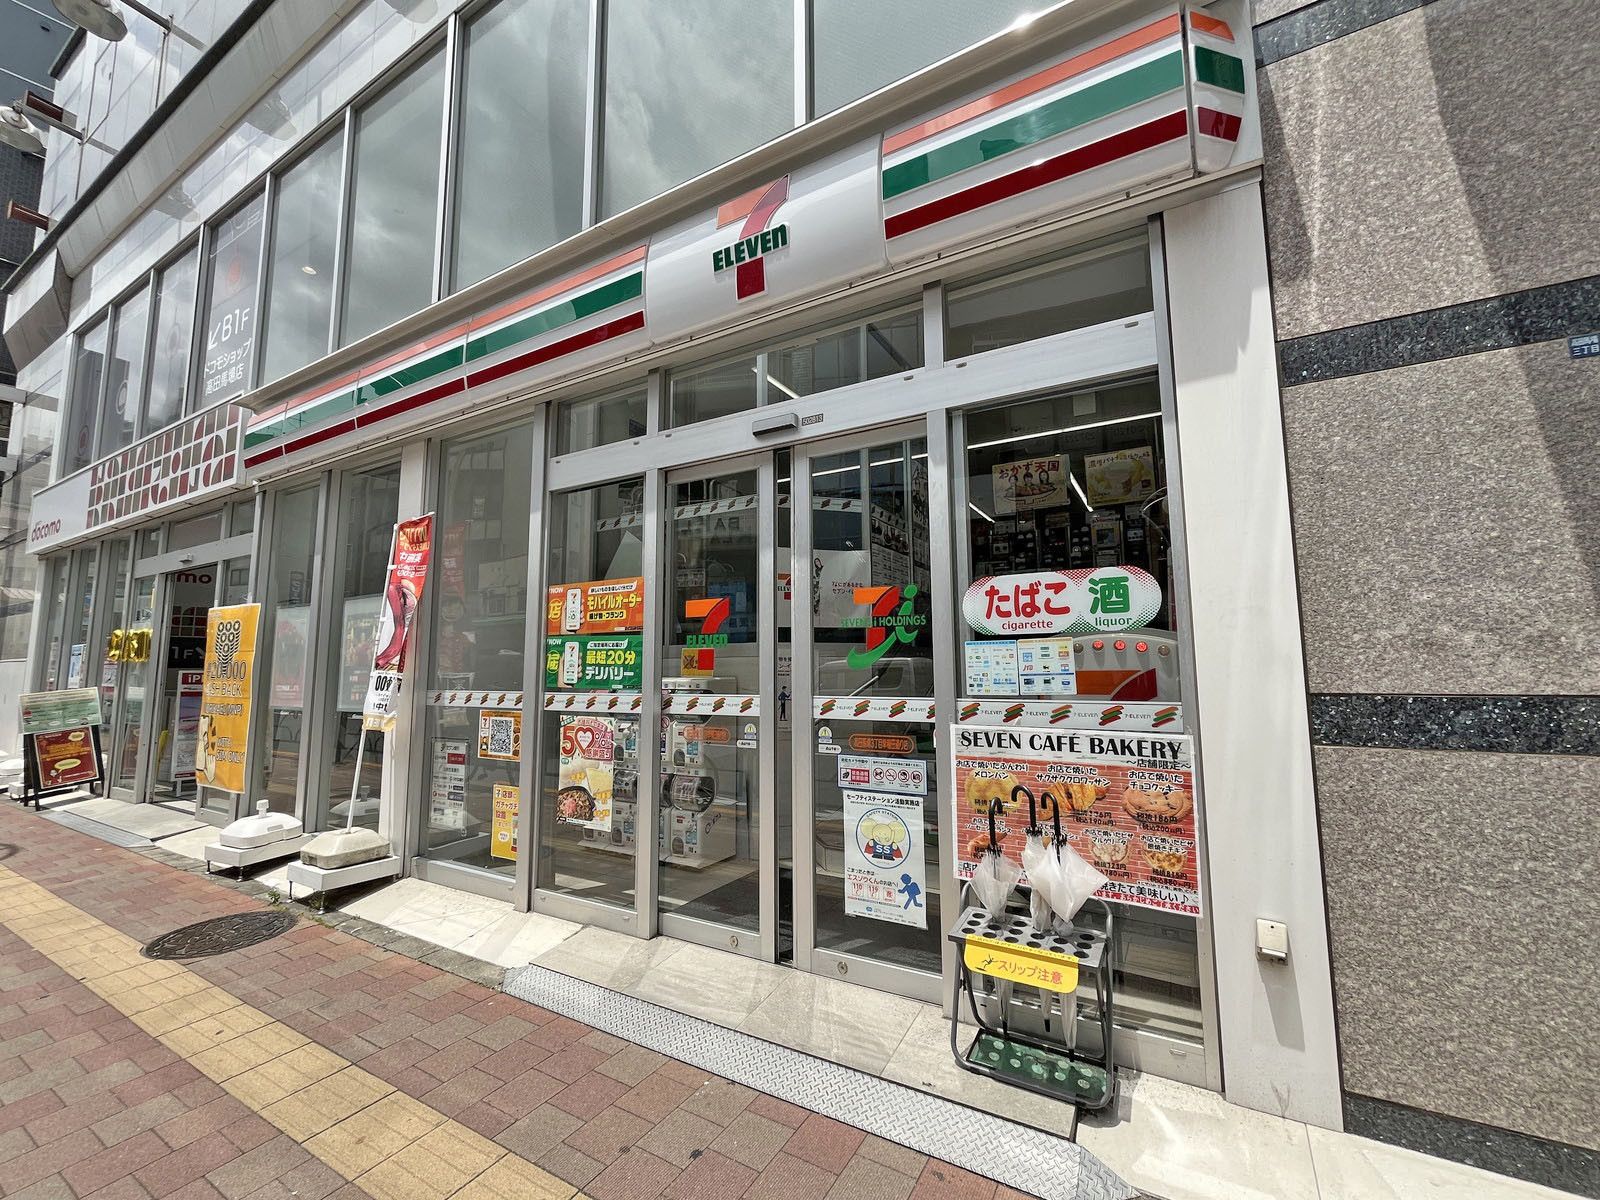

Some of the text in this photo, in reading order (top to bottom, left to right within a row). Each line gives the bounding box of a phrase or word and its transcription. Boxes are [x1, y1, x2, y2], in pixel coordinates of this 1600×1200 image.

[999, 460, 1060, 480] おかず天国
[31, 518, 61, 542] docomo
[587, 592, 642, 610] モバイルオーダー
[985, 580, 1070, 619] たばこ
[1088, 576, 1130, 614] 酒
[879, 615, 926, 627] HOLDINGS
[1001, 620, 1054, 632] cigarette
[1094, 616, 1133, 628] liquor
[585, 650, 636, 665] 最短20分
[585, 666, 634, 681] デリバリー
[960, 731, 1022, 749] SEVEN
[1089, 736, 1183, 760] BAKERY
[956, 759, 1029, 772] お店で焼いたふんわり
[1047, 765, 1097, 776] お店で焼いた
[974, 771, 1009, 780] メロンパン
[1128, 771, 1184, 783] お店で焼いた
[1130, 781, 1184, 793] チョコクッキー
[846, 793, 920, 807] セーフティステーション活動実施店
[876, 845, 891, 854] SS
[997, 960, 1064, 985] スリップ注意
